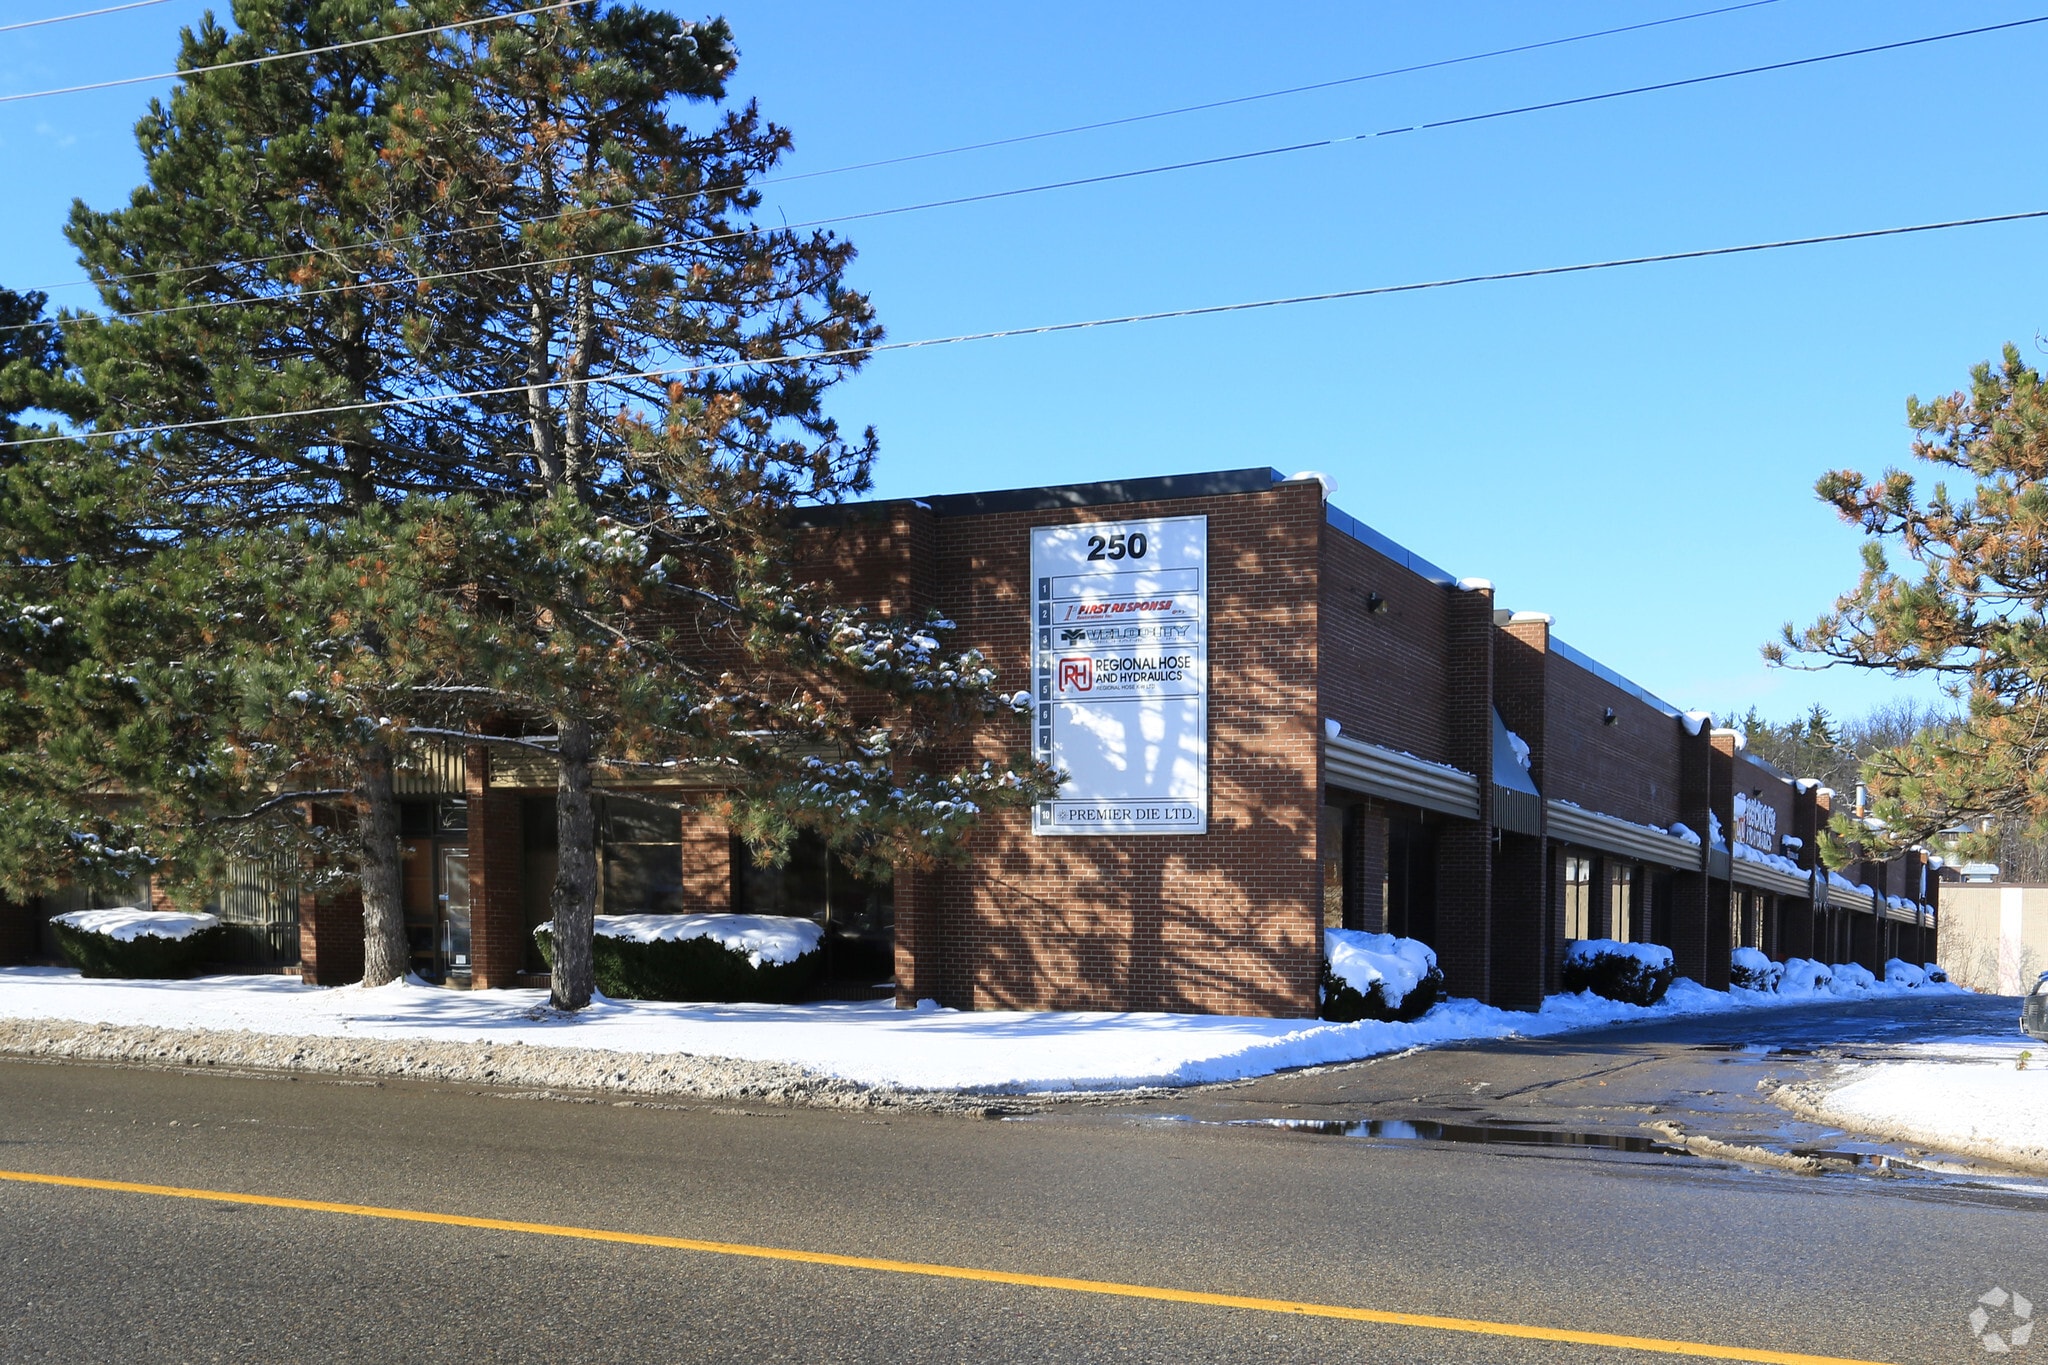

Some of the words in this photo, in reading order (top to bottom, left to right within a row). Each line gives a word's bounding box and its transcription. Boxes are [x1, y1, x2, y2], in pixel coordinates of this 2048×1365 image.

[1087, 532, 1147, 561] 250
[1042, 584, 1047, 593] 1
[1078, 603, 1111, 615] FIRST
[1111, 600, 1174, 613] RESPONSE
[1042, 610, 1048, 619] 2
[1086, 625, 1191, 641] VELOCITY
[1042, 635, 1048, 644] 3
[1042, 660, 1048, 669] 4
[1095, 657, 1156, 672] REGIONAL
[1159, 656, 1191, 669] HOSE
[1096, 672, 1118, 683] AND
[1120, 671, 1183, 683] HYDRAULICS
[1042, 685, 1048, 694] 5
[1042, 711, 1048, 719] 6
[1042, 735, 1048, 744] 7
[1041, 811, 1050, 819] 10
[1069, 808, 1132, 821] PREMIER
[1136, 808, 1160, 820] DIE
[1165, 808, 1195, 820] LTD.
